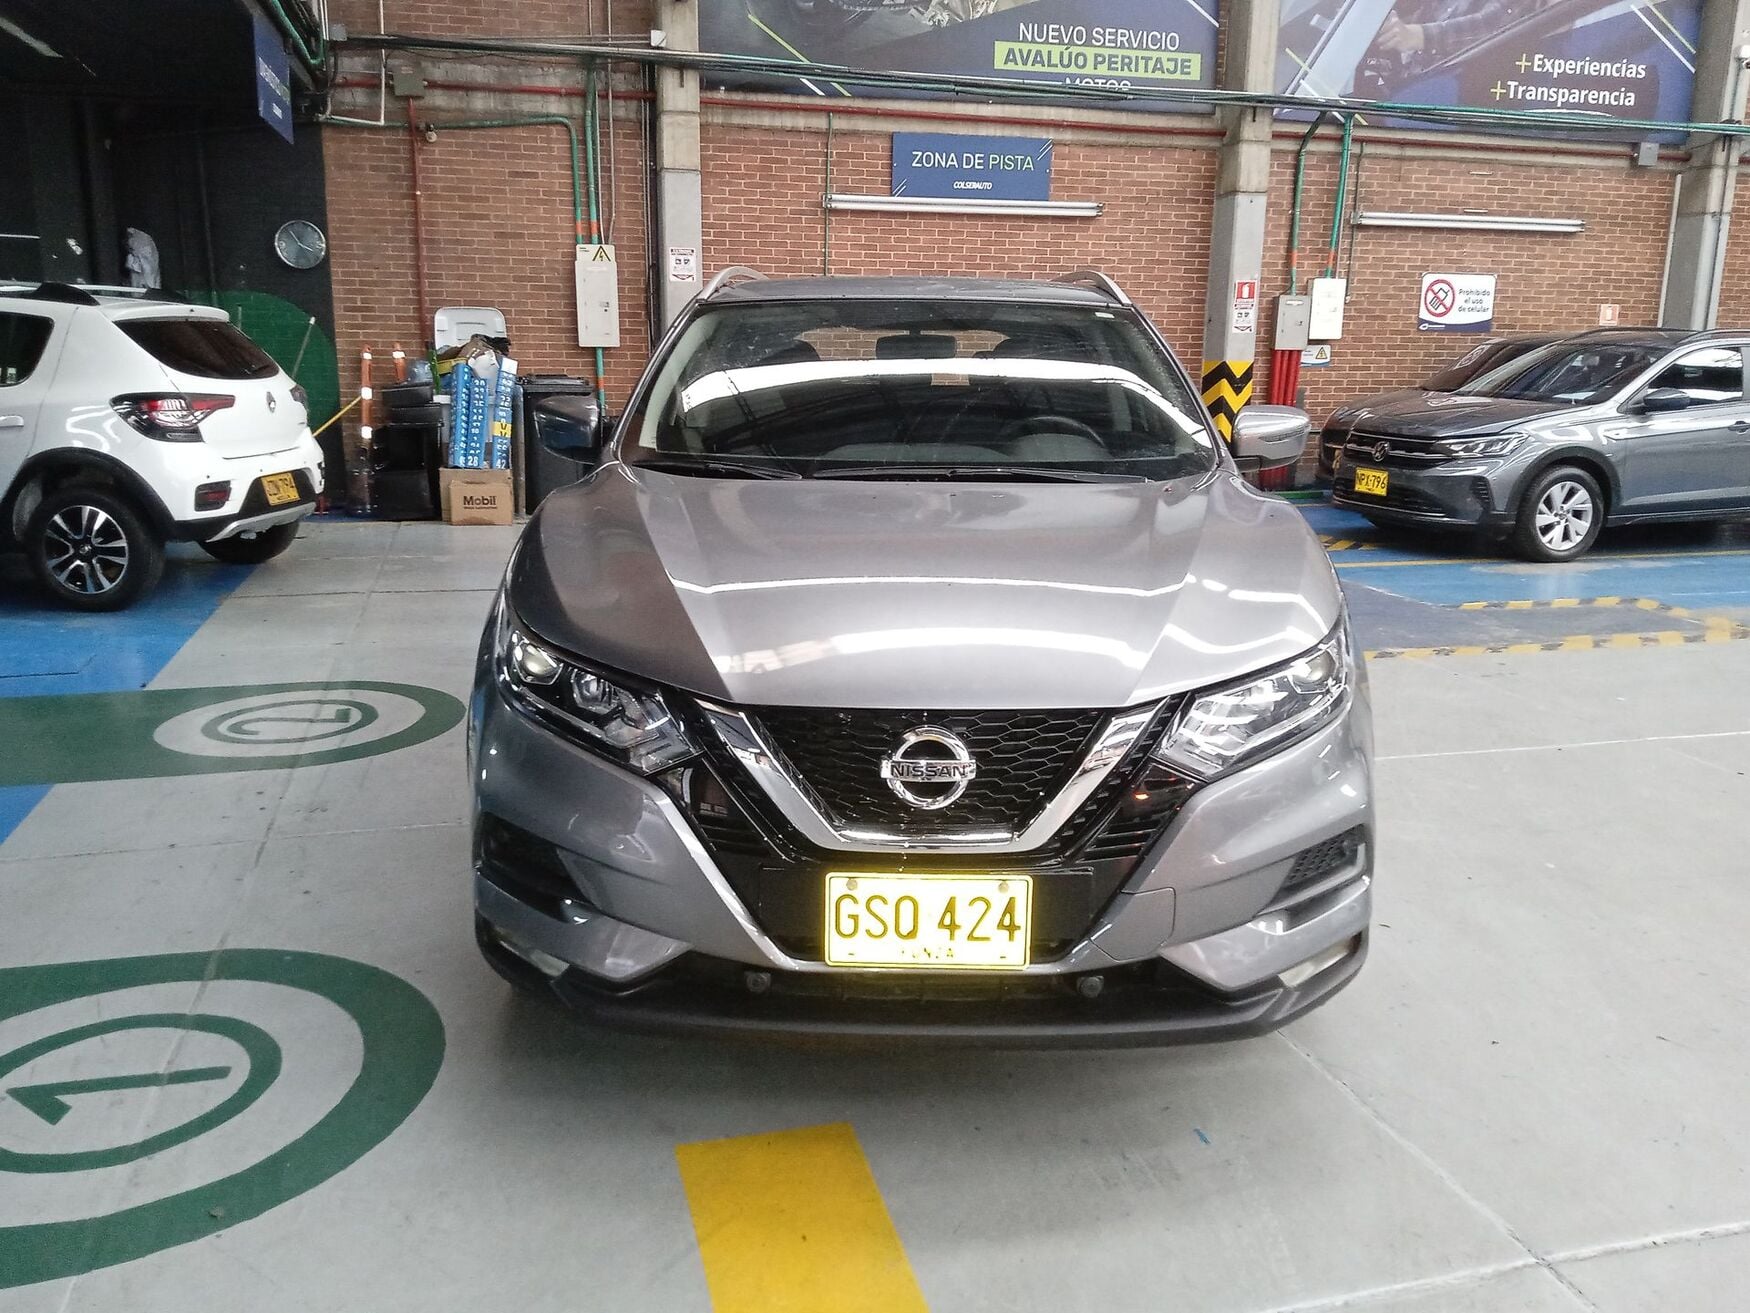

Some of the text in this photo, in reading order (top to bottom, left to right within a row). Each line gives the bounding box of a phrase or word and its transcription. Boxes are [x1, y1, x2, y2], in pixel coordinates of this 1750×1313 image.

[1019, 22, 1180, 51] NUEVO SERVICIO
[1003, 46, 1192, 75] AVALÚO PERITAJE
[911, 151, 1034, 171] ZONA DE PISTA
[463, 495, 497, 506] Mobil
[890, 764, 967, 777] NISSAN
[835, 893, 1022, 942] GSQ 424
[5, 1066, 232, 1126] 1
